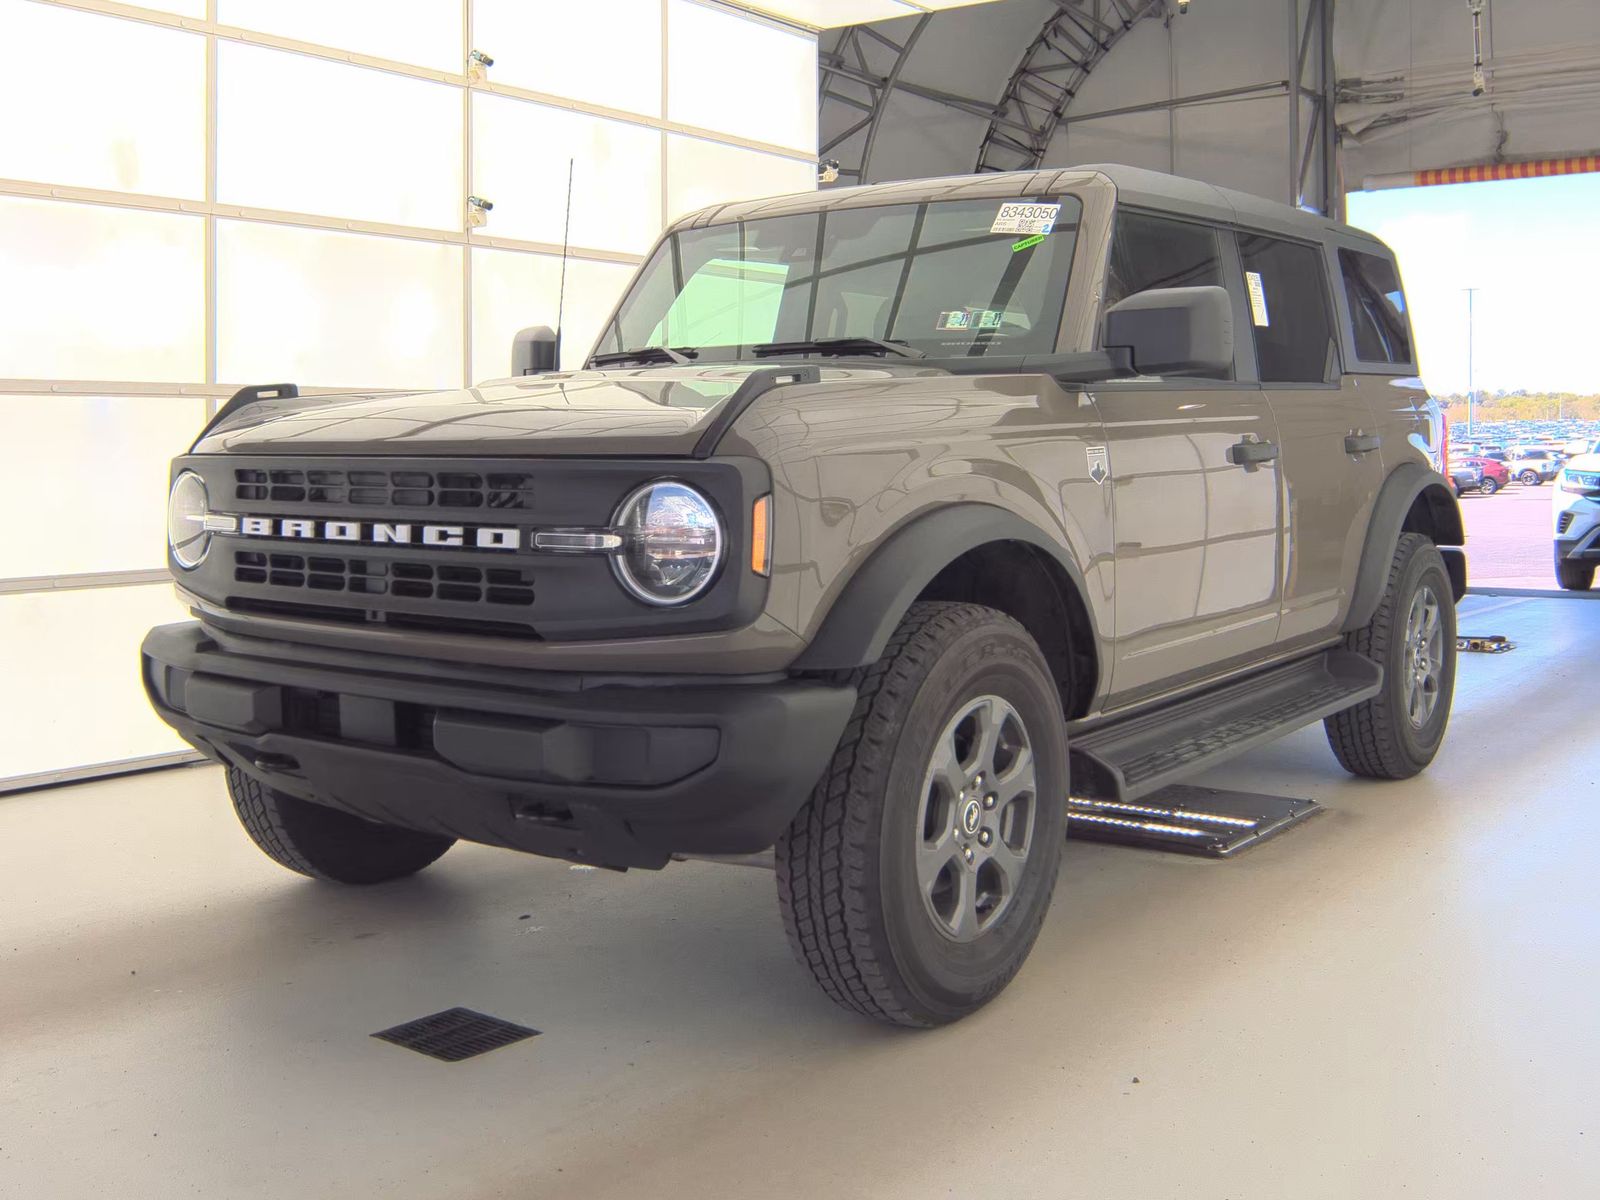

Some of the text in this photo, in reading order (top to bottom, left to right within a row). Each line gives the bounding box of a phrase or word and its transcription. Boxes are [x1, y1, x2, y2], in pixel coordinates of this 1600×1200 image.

[1001, 206, 1059, 219] 8343050
[1041, 224, 1050, 233] 2
[241, 516, 520, 549] BRONCO
